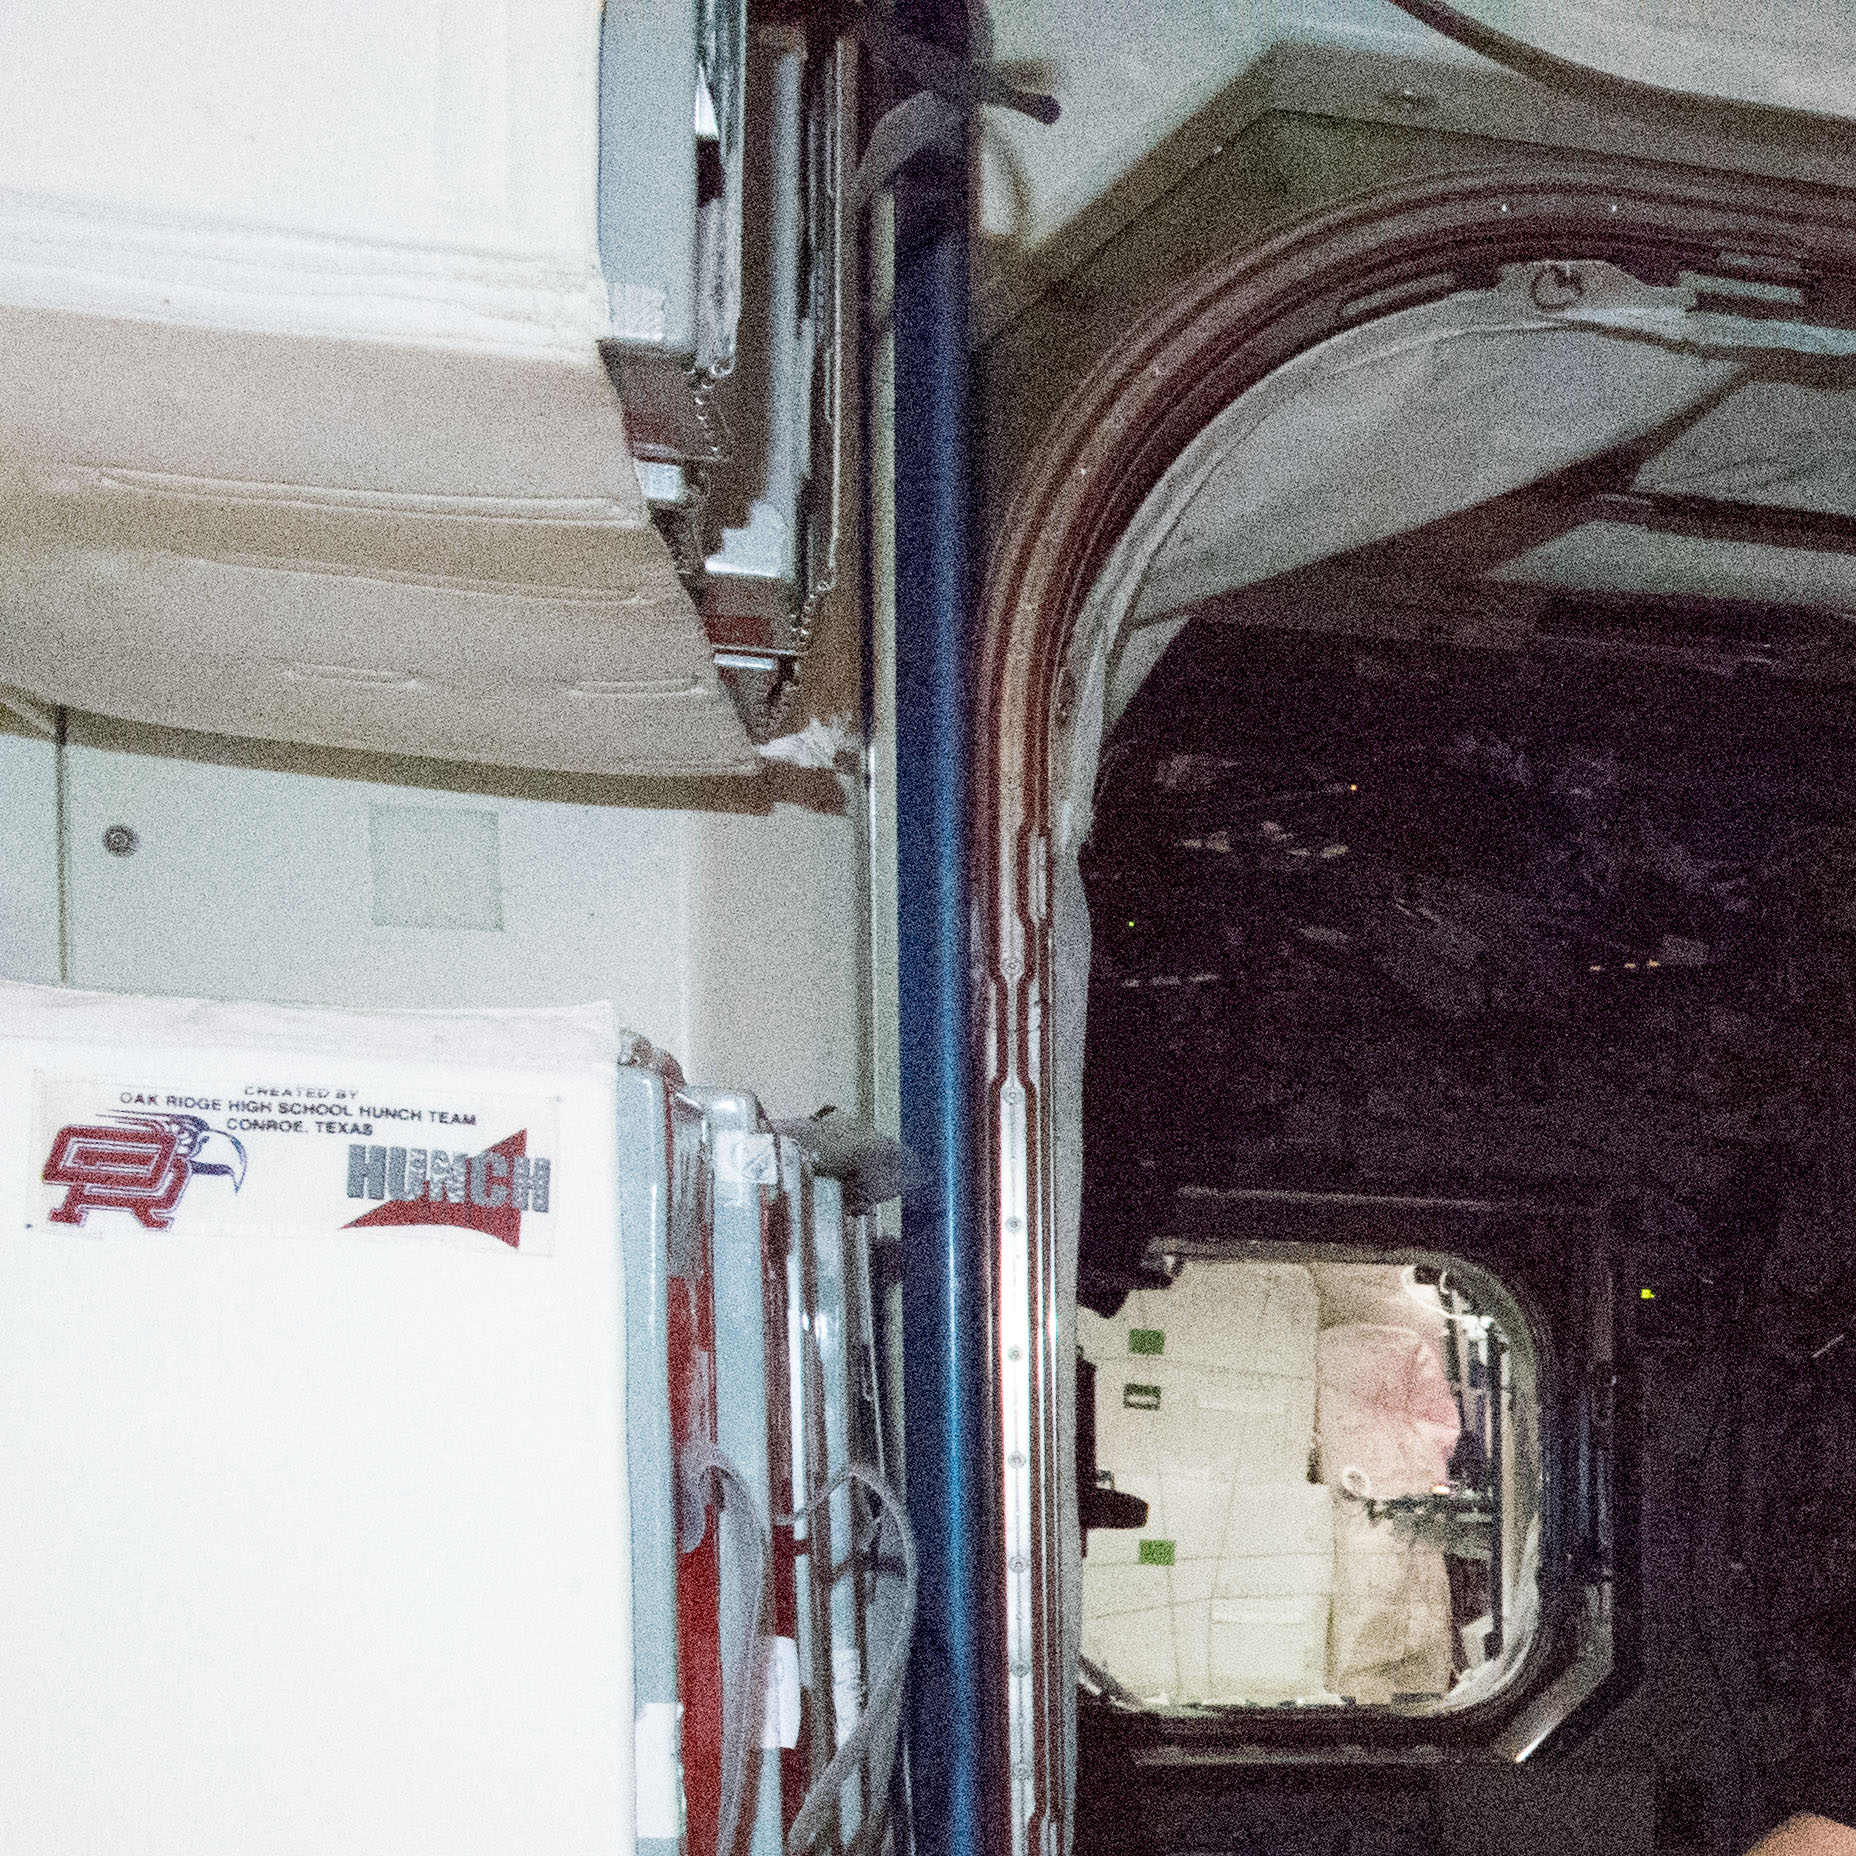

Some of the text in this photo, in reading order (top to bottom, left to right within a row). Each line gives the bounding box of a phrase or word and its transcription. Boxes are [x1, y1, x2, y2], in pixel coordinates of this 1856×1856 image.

[120, 1091, 477, 1126] OAK RIDGE HIGH SCHOOL HUNCH TEAM
[315, 1121, 373, 1136] TEXAS
[347, 1144, 550, 1213] HUNCH
